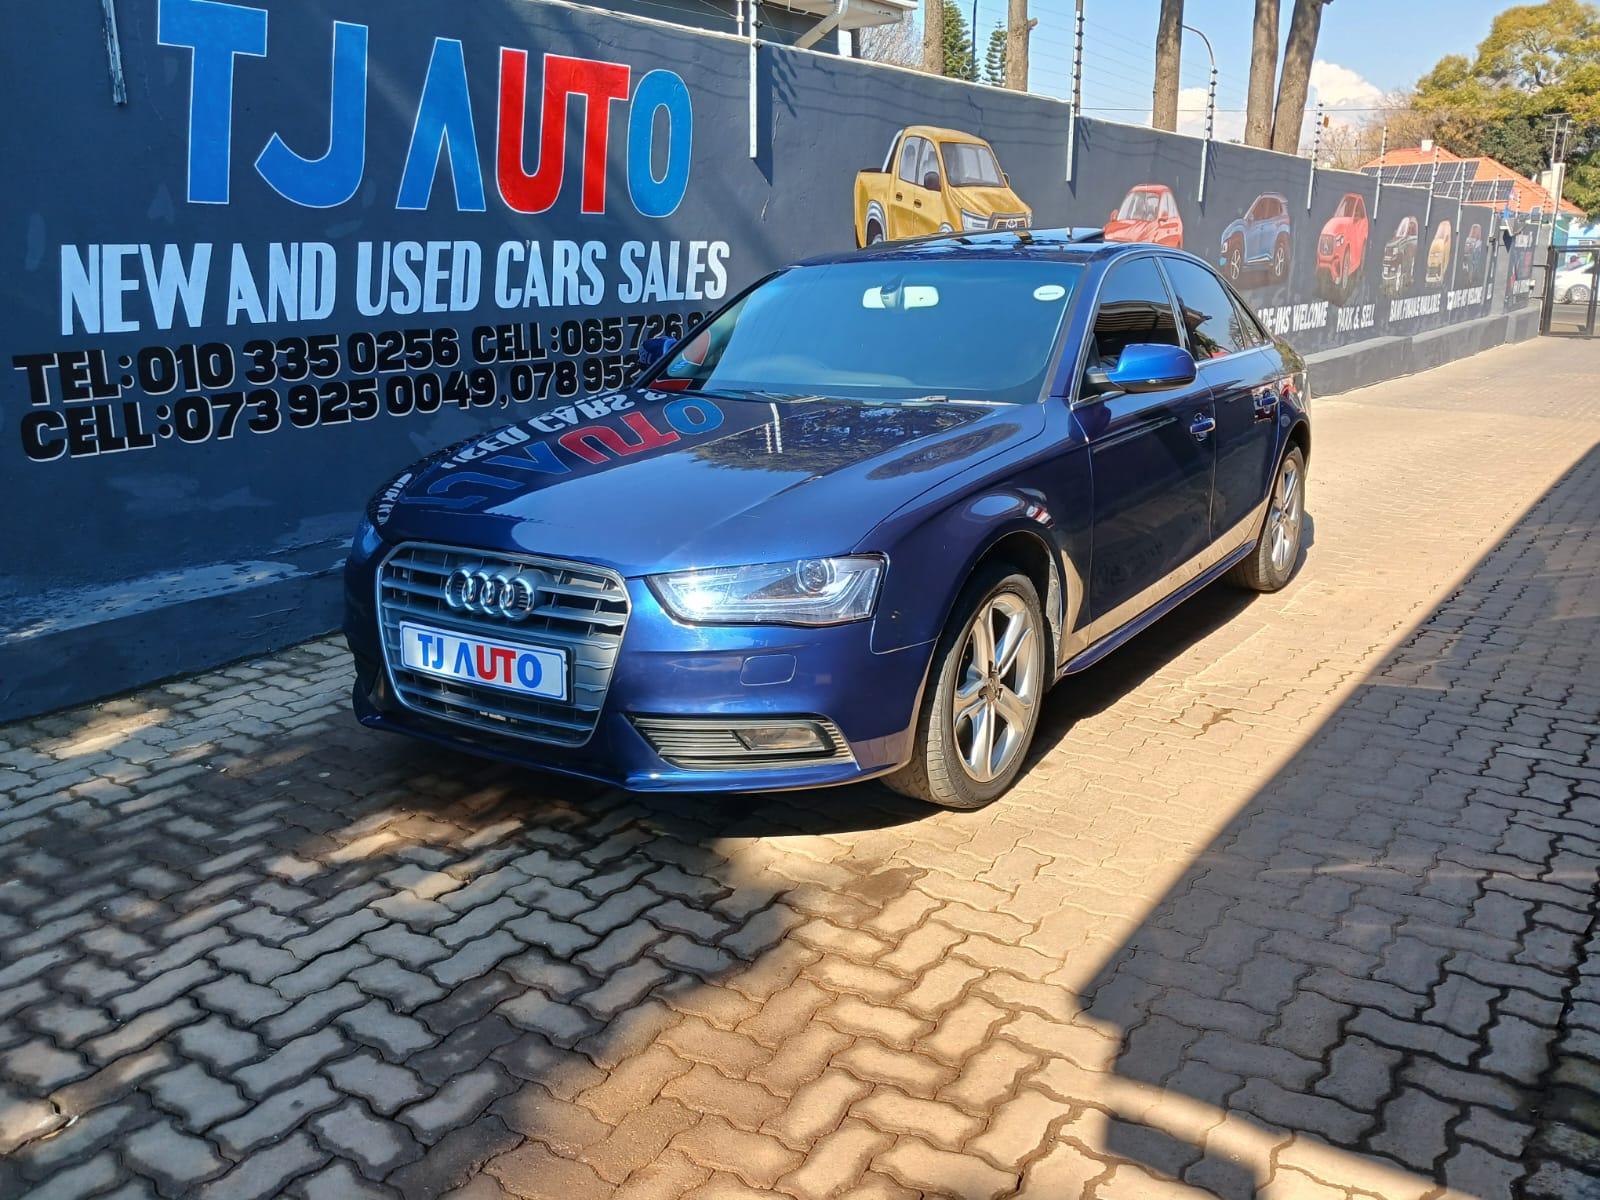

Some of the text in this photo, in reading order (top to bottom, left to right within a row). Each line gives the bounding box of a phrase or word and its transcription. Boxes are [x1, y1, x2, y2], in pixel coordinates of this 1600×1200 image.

[158, 0, 693, 218] TJ AUTO
[61, 239, 730, 336] NEW AND USED CARS SALES
[1292, 301, 1329, 332] WELCOME
[1337, 306, 1355, 332] PARK
[1360, 303, 1376, 328] SELL
[243, 334, 341, 386] 335
[347, 327, 461, 376] 0256
[628, 312, 685, 353] 726
[288, 377, 380, 429] 925
[417, 633, 543, 689] TJ AUTO
